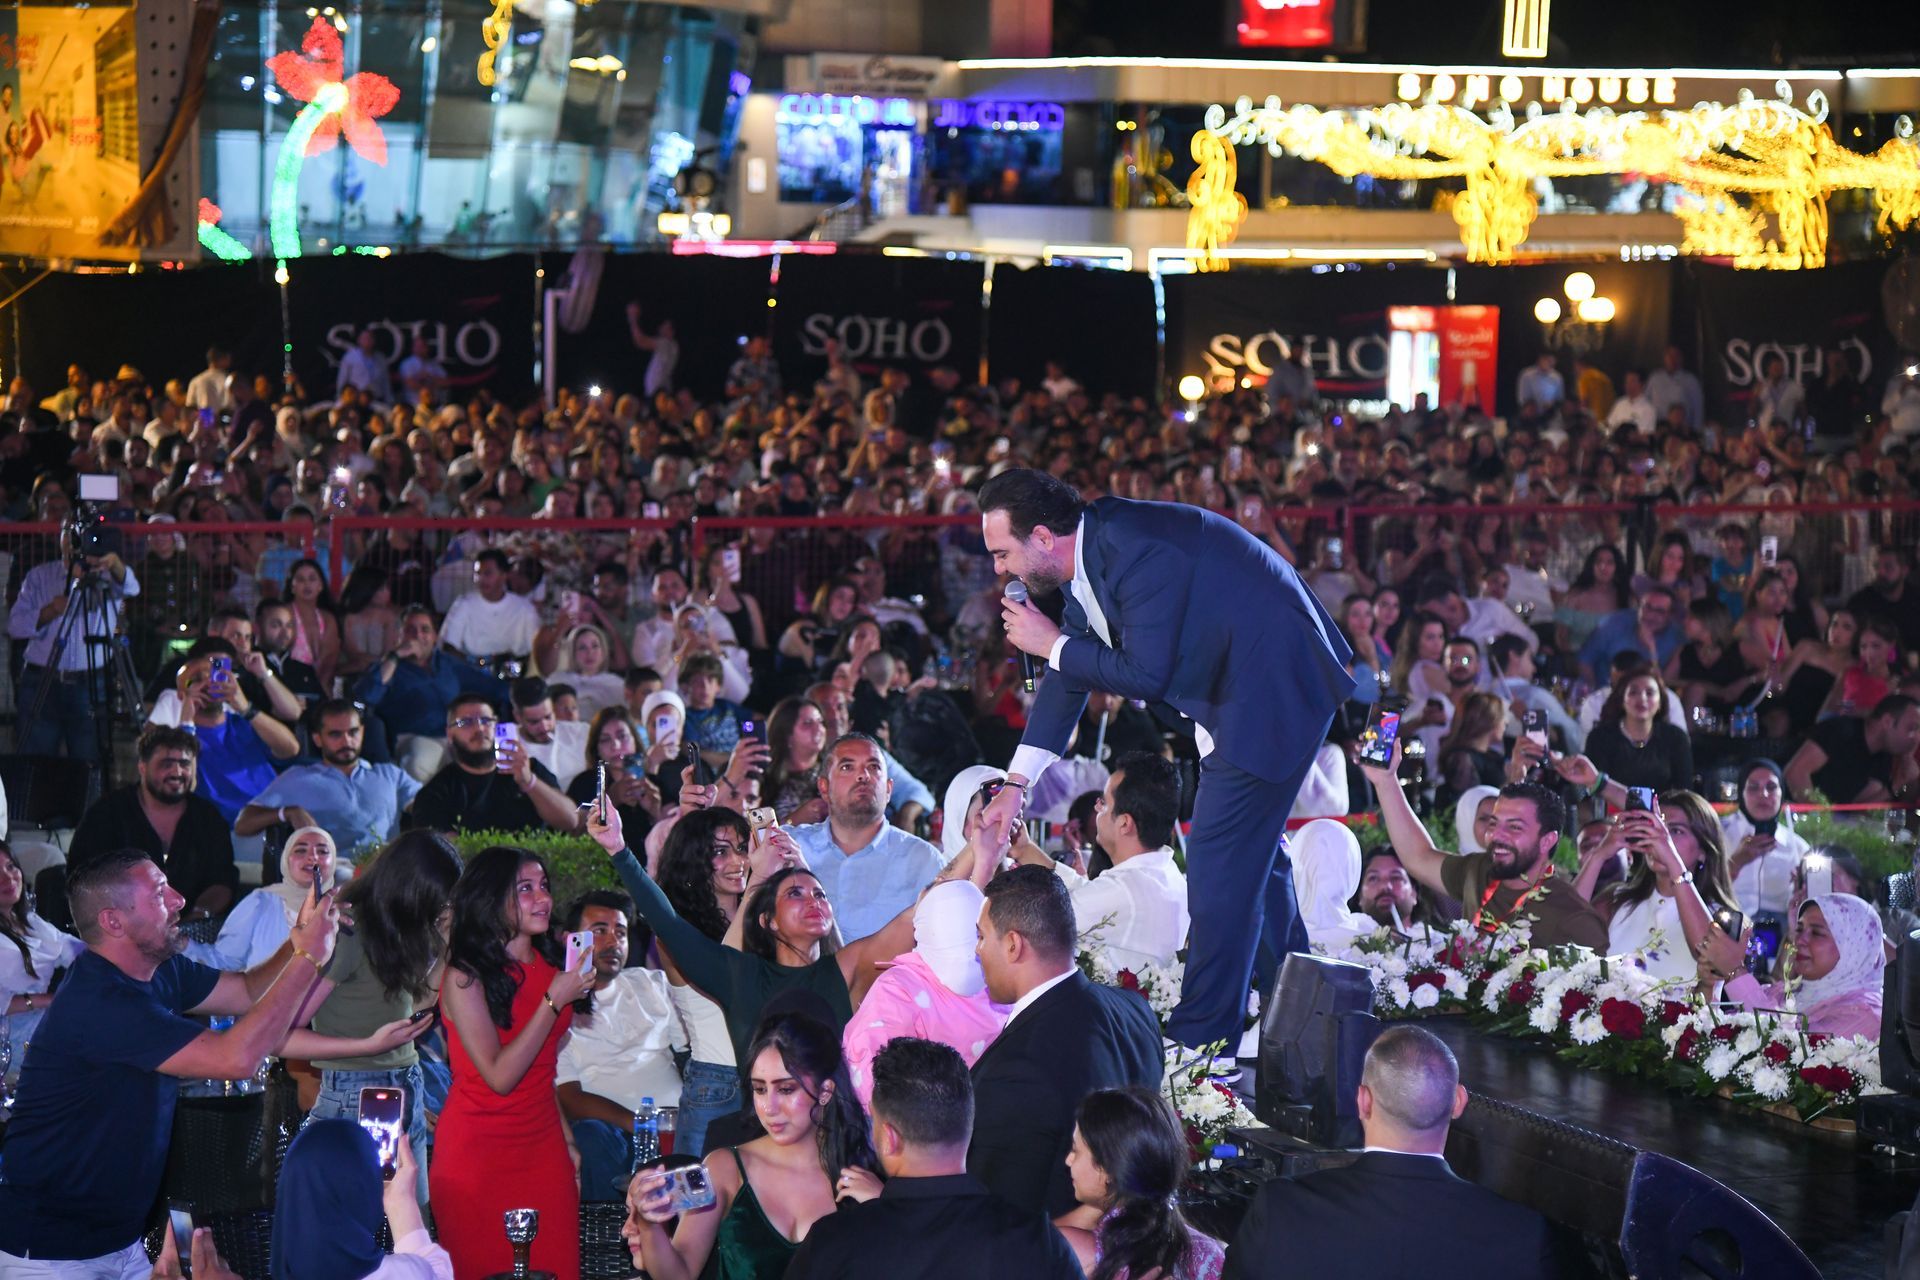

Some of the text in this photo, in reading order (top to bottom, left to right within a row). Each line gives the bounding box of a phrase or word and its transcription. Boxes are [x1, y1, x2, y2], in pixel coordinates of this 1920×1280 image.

[1397, 72, 1676, 104] SOHO HOUSE
[319, 318, 501, 368] SOHO
[797, 311, 952, 362] SOHO
[1200, 329, 1389, 379] SOHO
